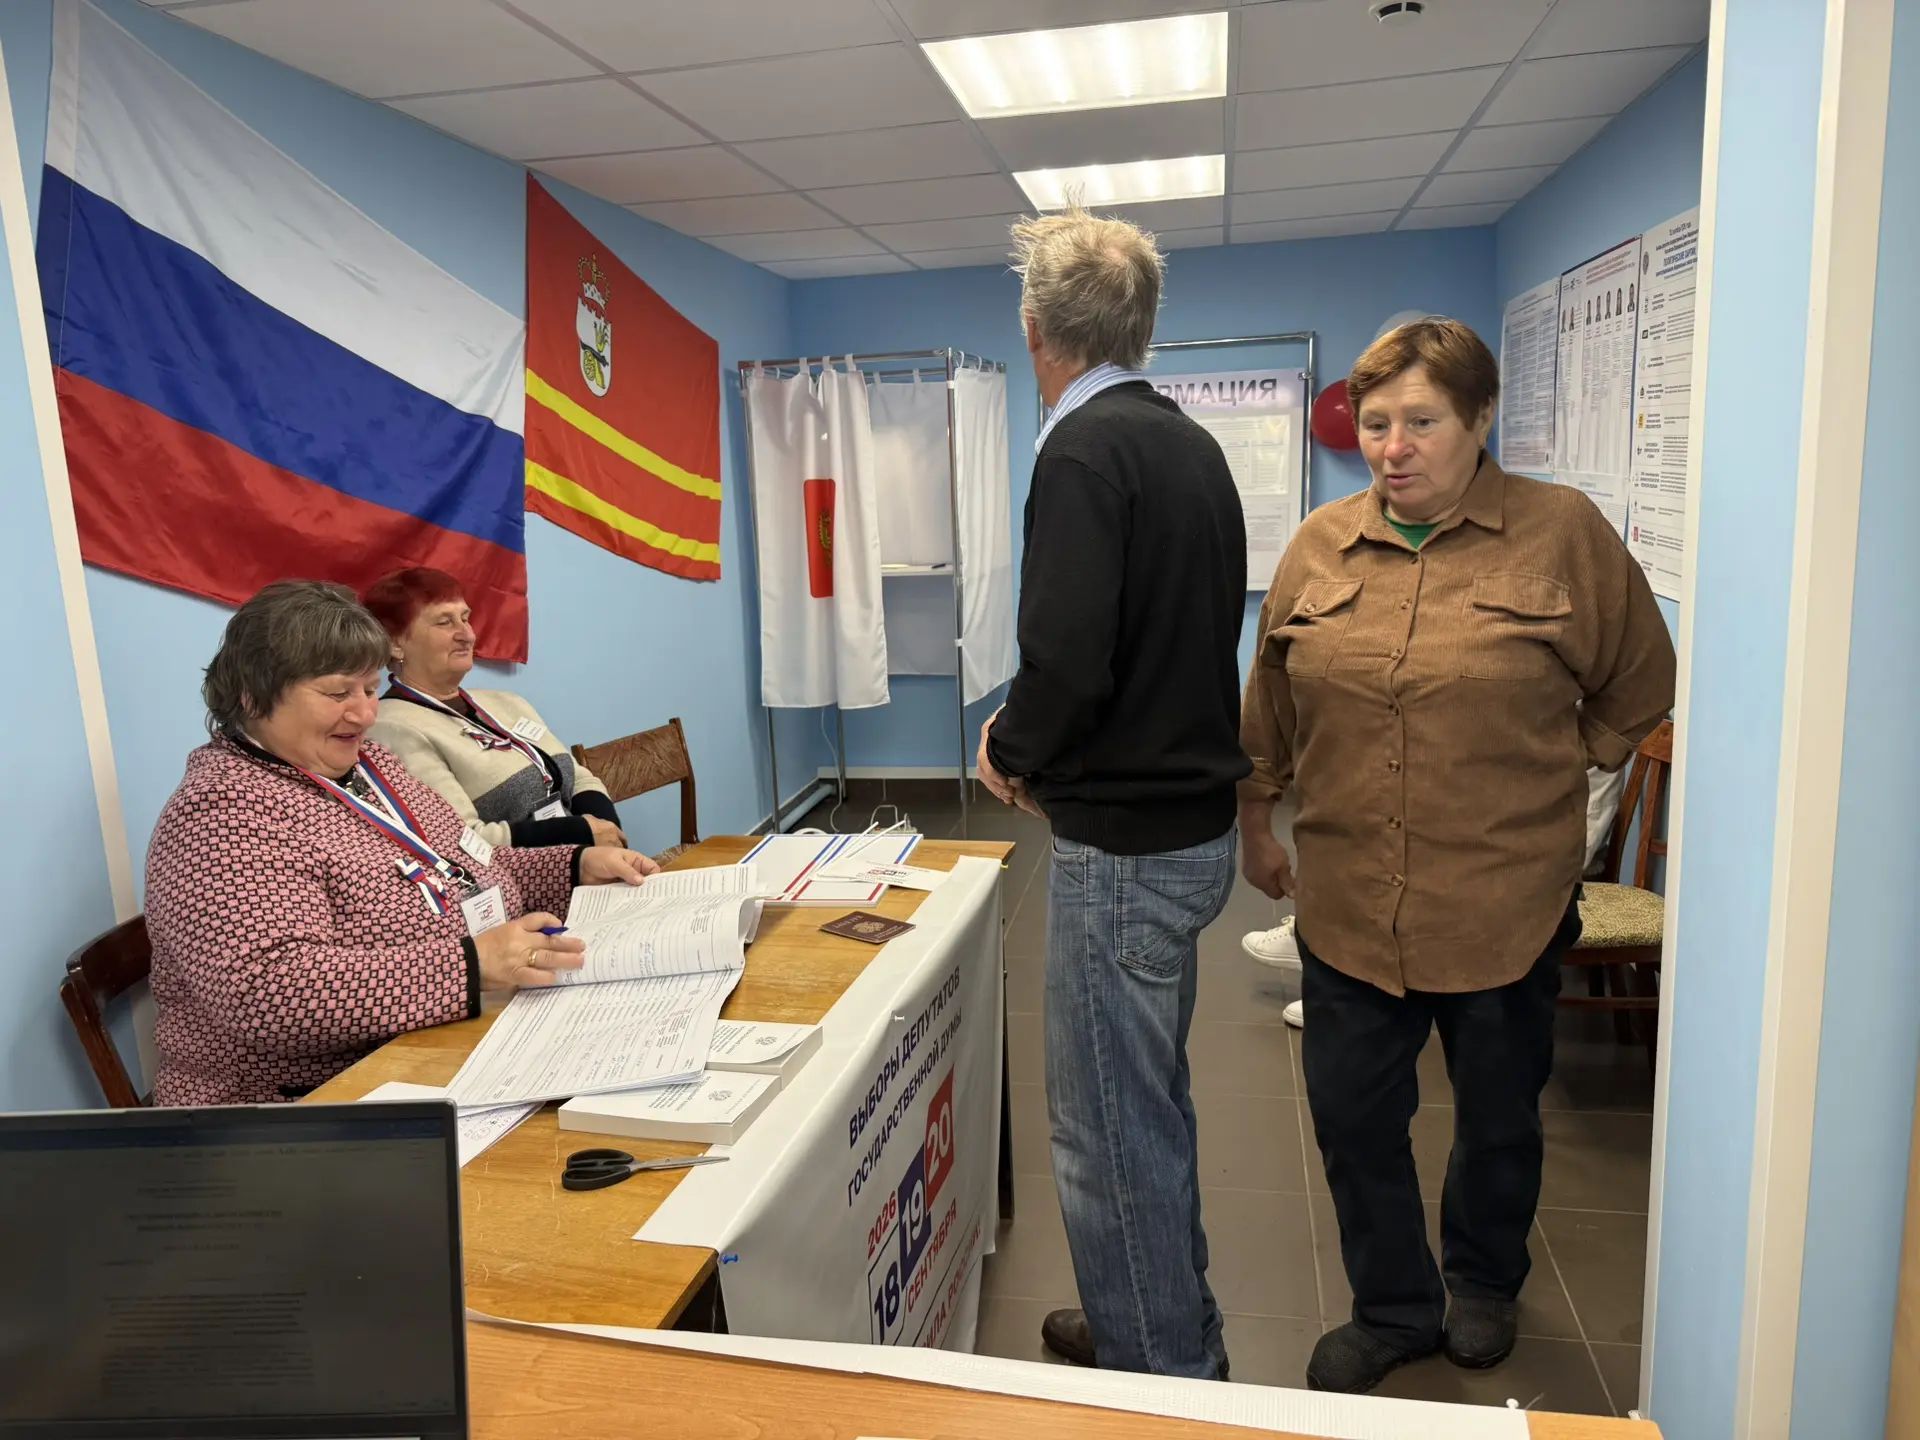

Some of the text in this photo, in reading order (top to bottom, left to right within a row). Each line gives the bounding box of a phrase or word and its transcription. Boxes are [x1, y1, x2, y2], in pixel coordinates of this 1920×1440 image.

[1156, 378, 1277, 406] РМАЦИЯ
[849, 965, 960, 1149] ВЫБОРЫ ДЕПУТАТОВ
[848, 1007, 962, 1208] ГОСУДАРСТВЕННОЙ ДУМЫ
[927, 1101, 951, 1185] 20
[868, 1191, 897, 1260] 2026
[901, 1179, 925, 1258] 19
[907, 1197, 958, 1313] СЕНТЯБРЯ
[874, 1261, 901, 1347] 18
[922, 1301, 947, 1348] ИЛА
